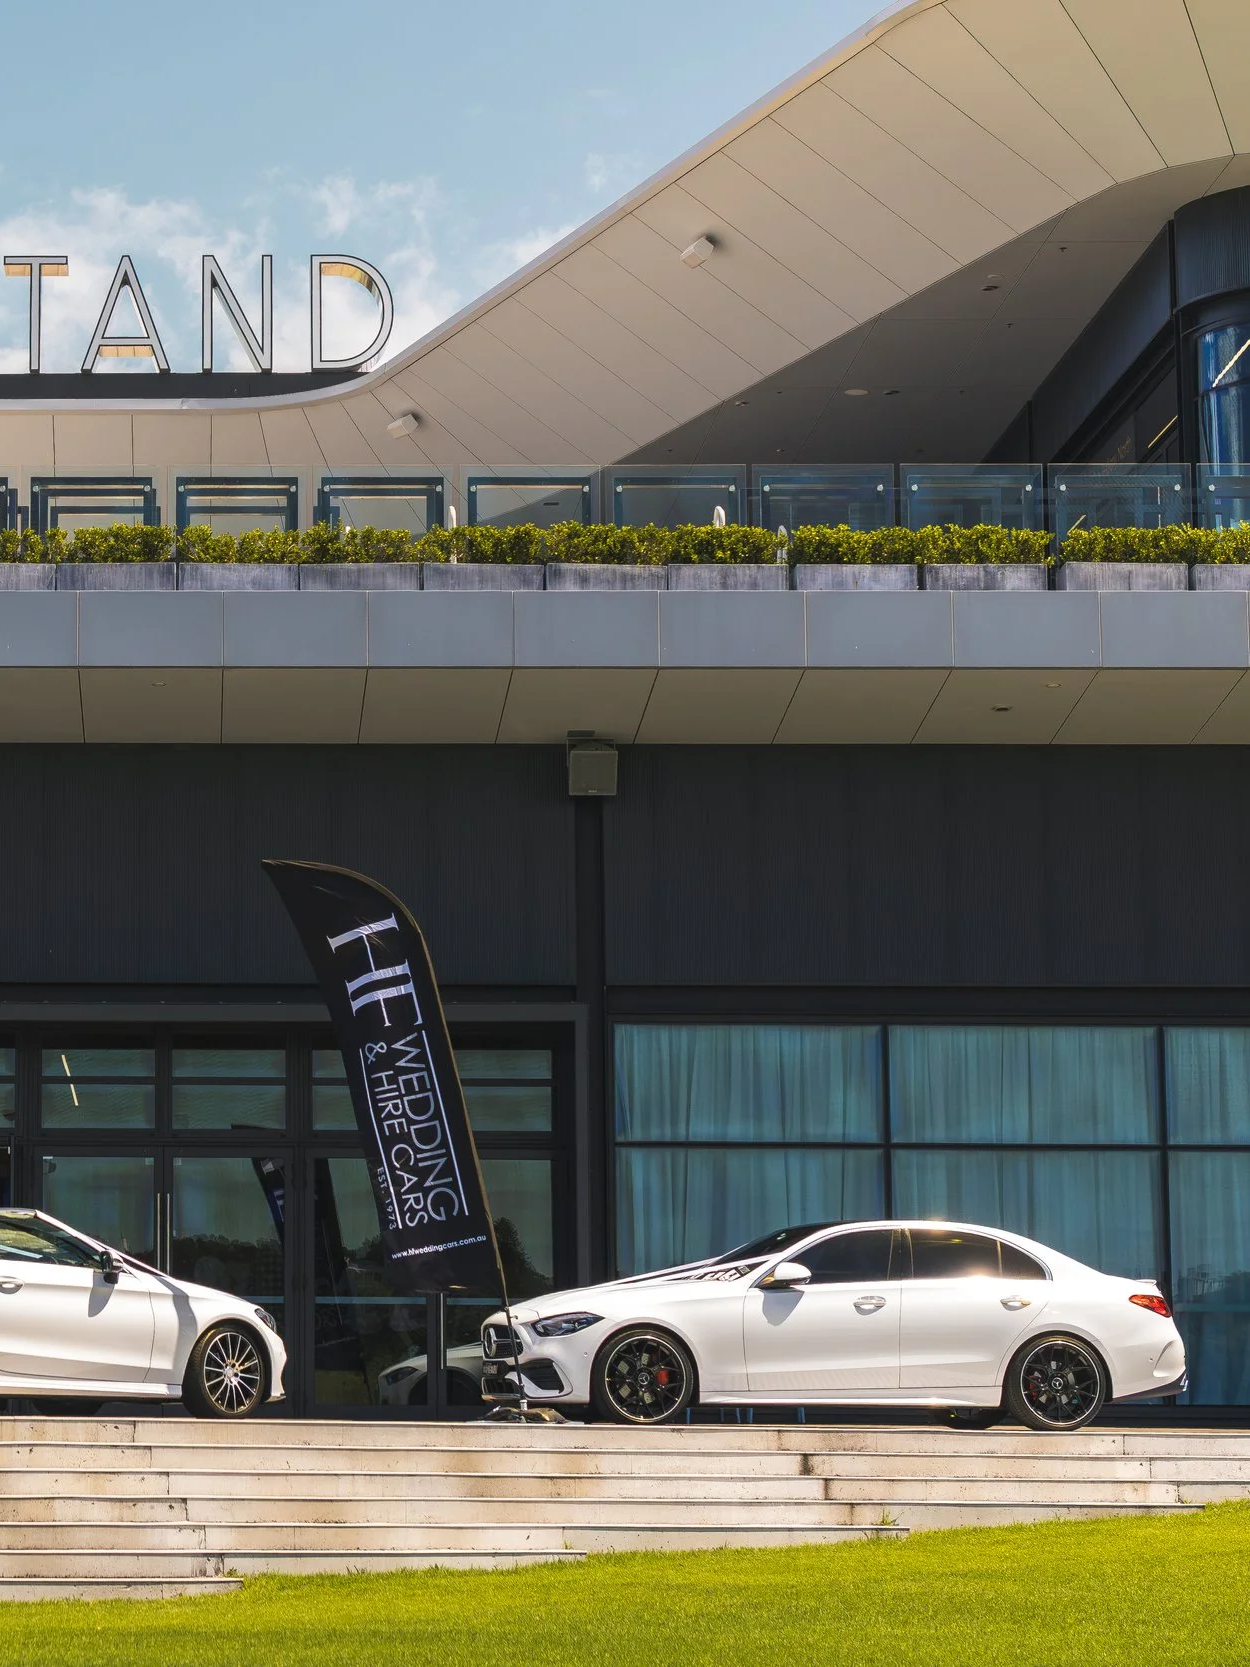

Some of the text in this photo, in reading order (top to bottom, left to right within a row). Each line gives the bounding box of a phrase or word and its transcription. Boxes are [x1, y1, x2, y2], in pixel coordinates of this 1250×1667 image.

[326, 912, 423, 1027] HF
[365, 1041, 429, 1227] & HIRE CARS
[391, 1031, 459, 1221] WEDDING
[377, 1167, 397, 1230] EST. 1973
[391, 1234, 487, 1260] www.hfweddingcars.com.au
